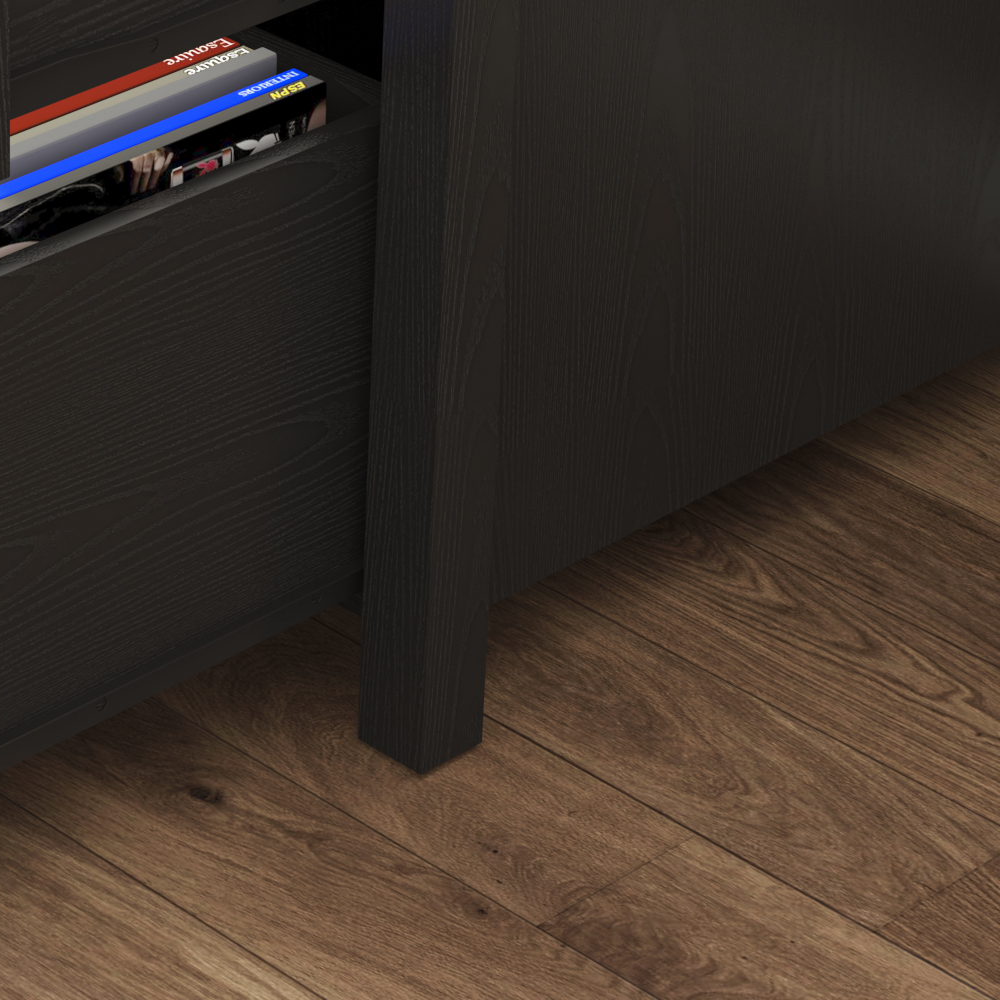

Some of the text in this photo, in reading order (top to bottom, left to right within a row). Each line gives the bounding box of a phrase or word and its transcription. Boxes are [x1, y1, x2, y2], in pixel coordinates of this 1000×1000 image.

[183, 48, 250, 76] Esquire
[237, 70, 301, 98] INTERIORS
[269, 80, 307, 101] ESPN
